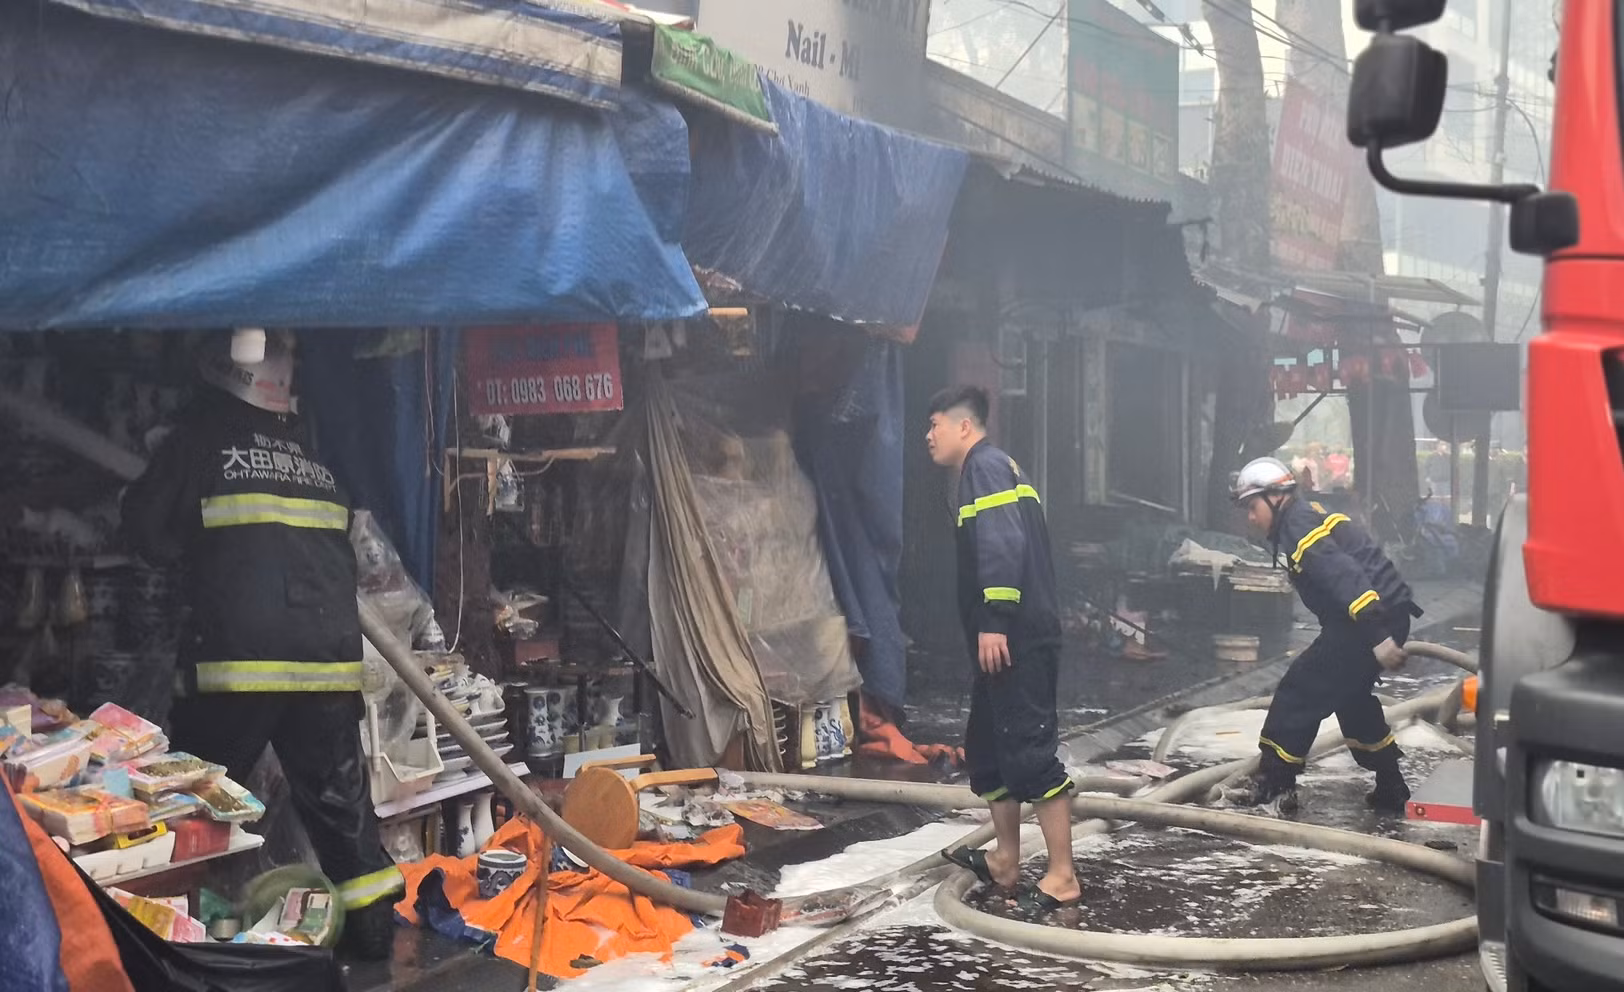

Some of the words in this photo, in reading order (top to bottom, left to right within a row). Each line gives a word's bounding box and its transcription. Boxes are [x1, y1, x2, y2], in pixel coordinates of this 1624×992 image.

[785, 19, 827, 70] Nail
[511, 377, 546, 405] 0983
[554, 375, 581, 402] 068
[585, 372, 613, 400] 676
[224, 469, 291, 482] OHTAWARA
